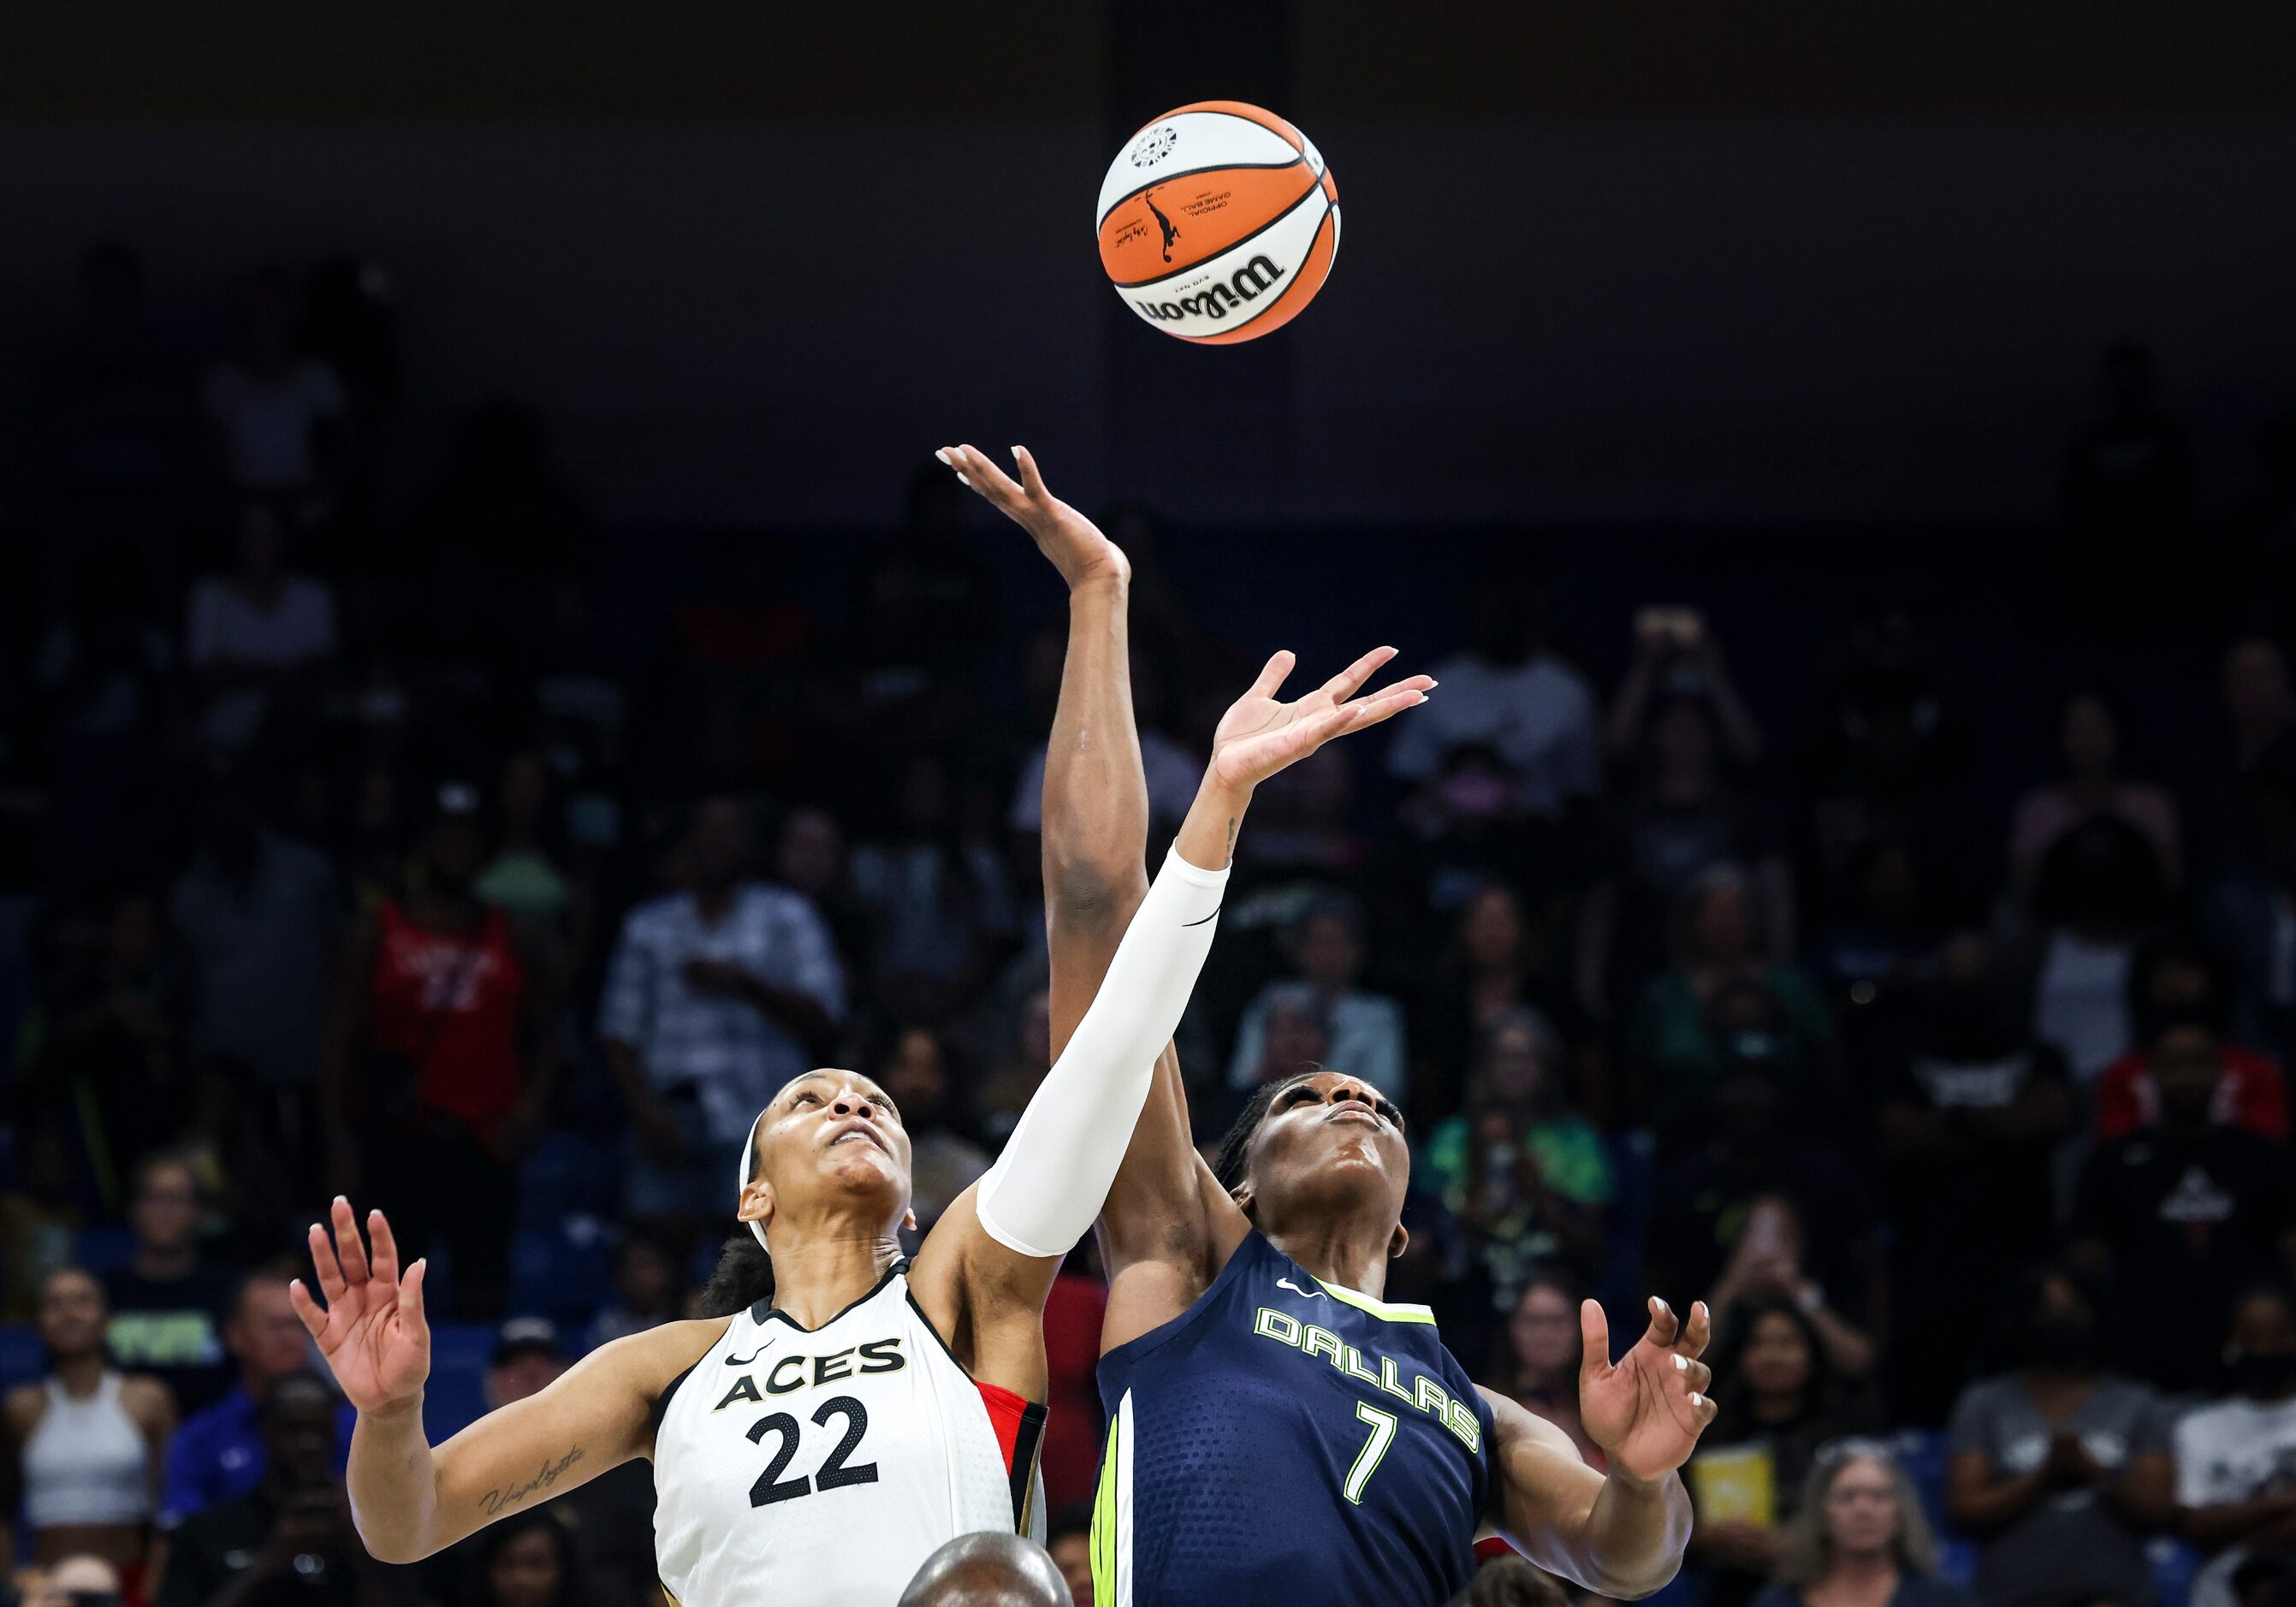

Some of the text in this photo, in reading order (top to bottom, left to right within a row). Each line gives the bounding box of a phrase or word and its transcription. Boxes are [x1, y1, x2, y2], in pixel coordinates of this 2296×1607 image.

[1180, 201, 1203, 213] BALL
[1188, 201, 1228, 217] OFFICIAL
[1205, 192, 1231, 205] GAME
[1136, 253, 1286, 321] Wilson
[711, 1337, 907, 1413] ACES
[1253, 1306, 1480, 1455] DALLAS
[745, 1395, 879, 1509] 22
[1343, 1400, 1397, 1505] 7
